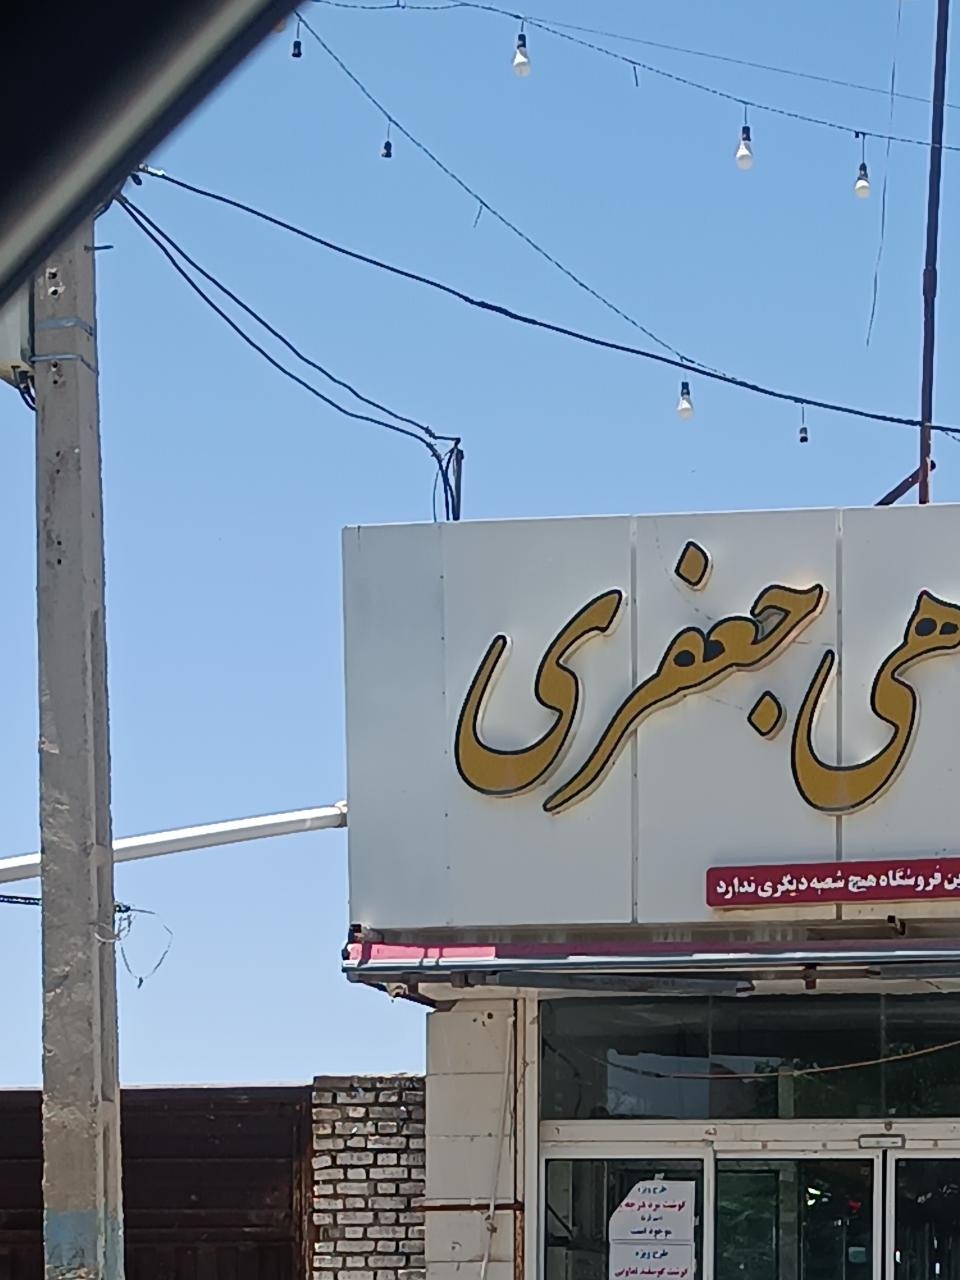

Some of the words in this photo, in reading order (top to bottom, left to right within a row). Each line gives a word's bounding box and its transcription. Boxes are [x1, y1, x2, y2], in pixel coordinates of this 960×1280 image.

[453, 539, 829, 815] جعفری
[716, 876, 756, 899] ندارد
[757, 873, 808, 898] دیگری
[810, 870, 844, 896] شعبه
[848, 873, 877, 893] هیچ
[878, 864, 942, 892] فروشگاه
